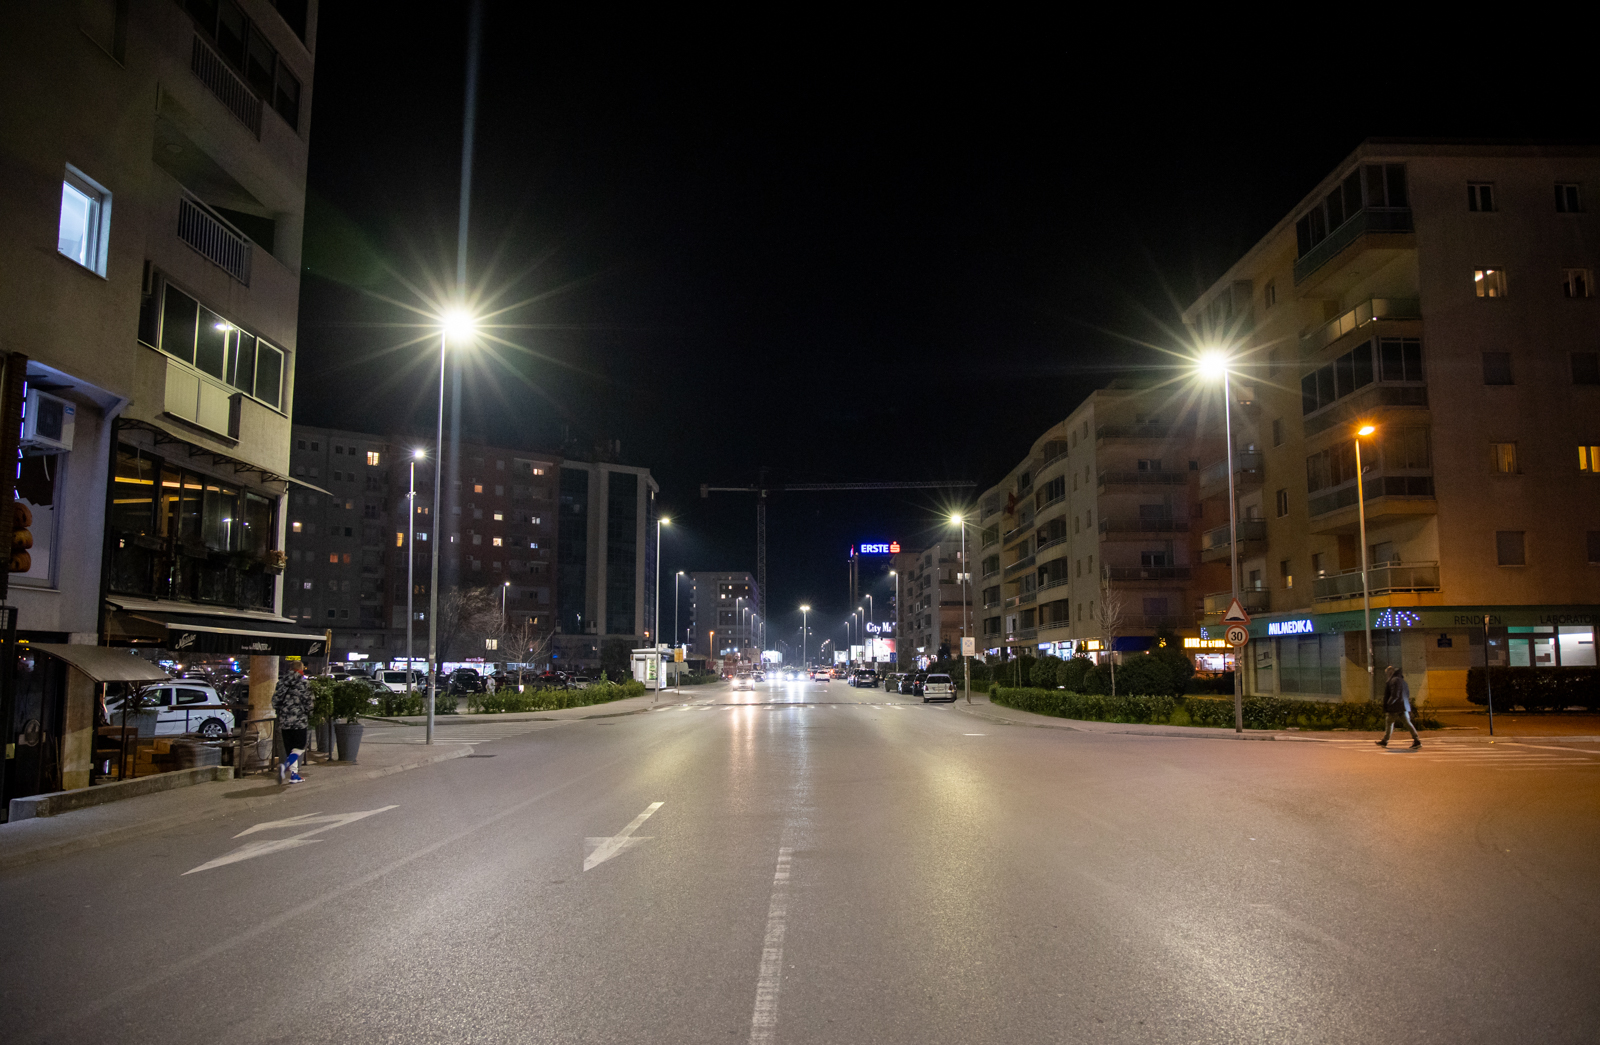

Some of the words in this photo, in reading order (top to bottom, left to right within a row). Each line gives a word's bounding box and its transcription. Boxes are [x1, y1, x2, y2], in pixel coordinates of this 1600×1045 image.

[860, 544, 889, 553] ERSTE
[866, 622, 881, 634] City
[1268, 619, 1313, 635] MILMEDIKA
[1230, 631, 1243, 641] 30
